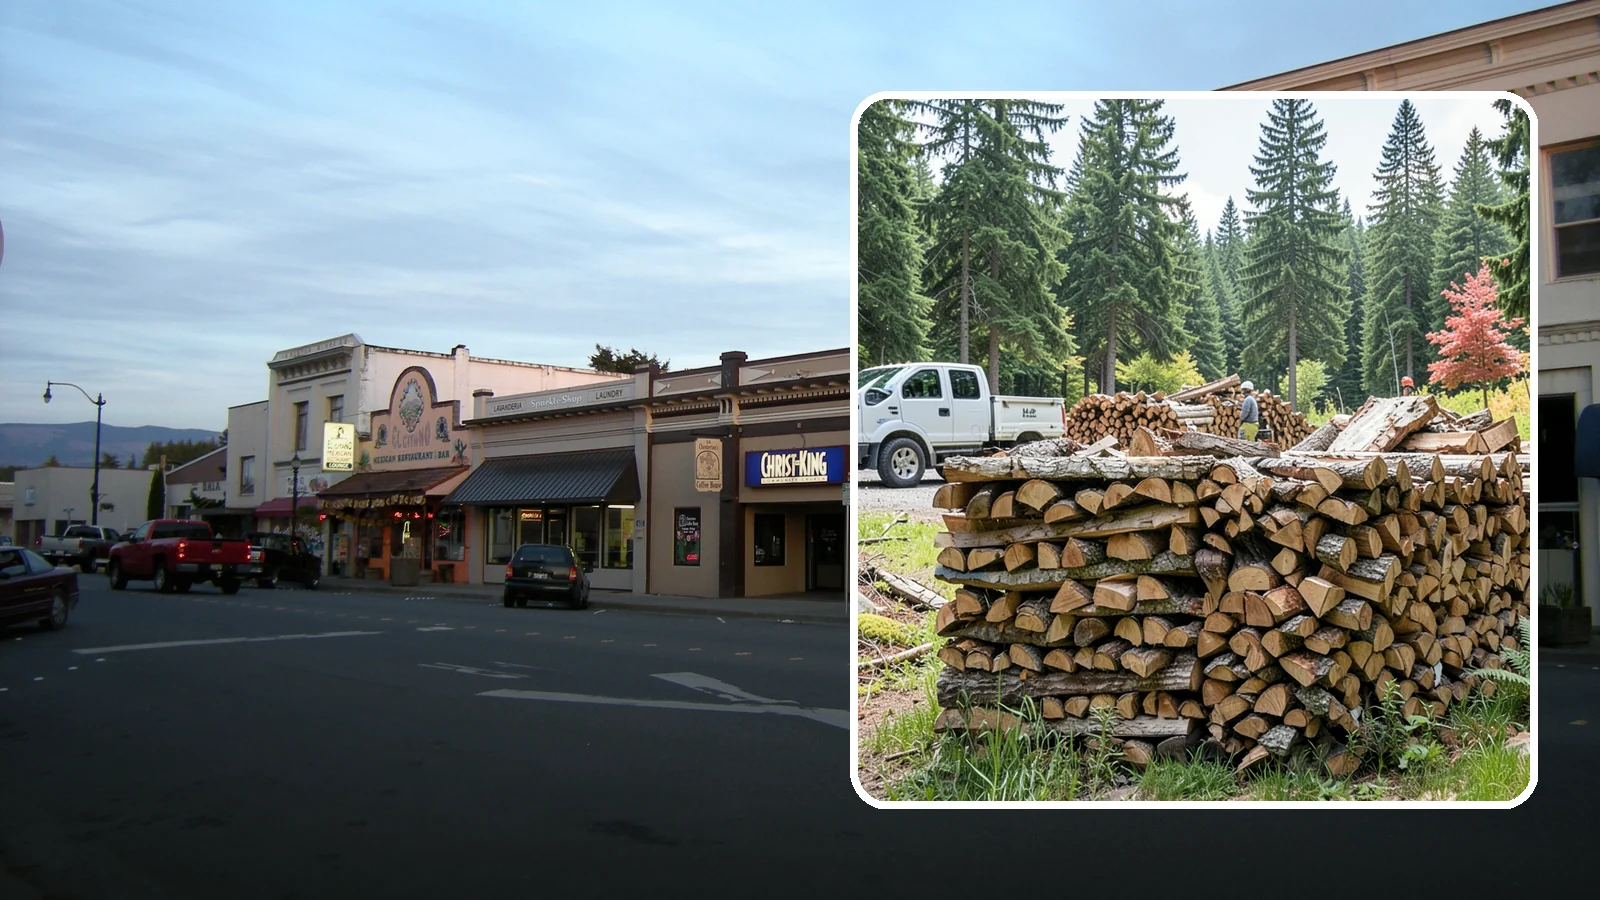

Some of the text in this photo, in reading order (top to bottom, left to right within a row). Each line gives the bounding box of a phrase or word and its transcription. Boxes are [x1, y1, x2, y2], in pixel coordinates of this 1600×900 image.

[562, 394, 582, 404] Shop
[595, 389, 623, 400] LAUNDRY
[493, 402, 522, 412] LAVANDERIA
[398, 452, 434, 462] RESTAURANT
[438, 450, 450, 459] BAR
[761, 450, 827, 478] CHRIST KING
